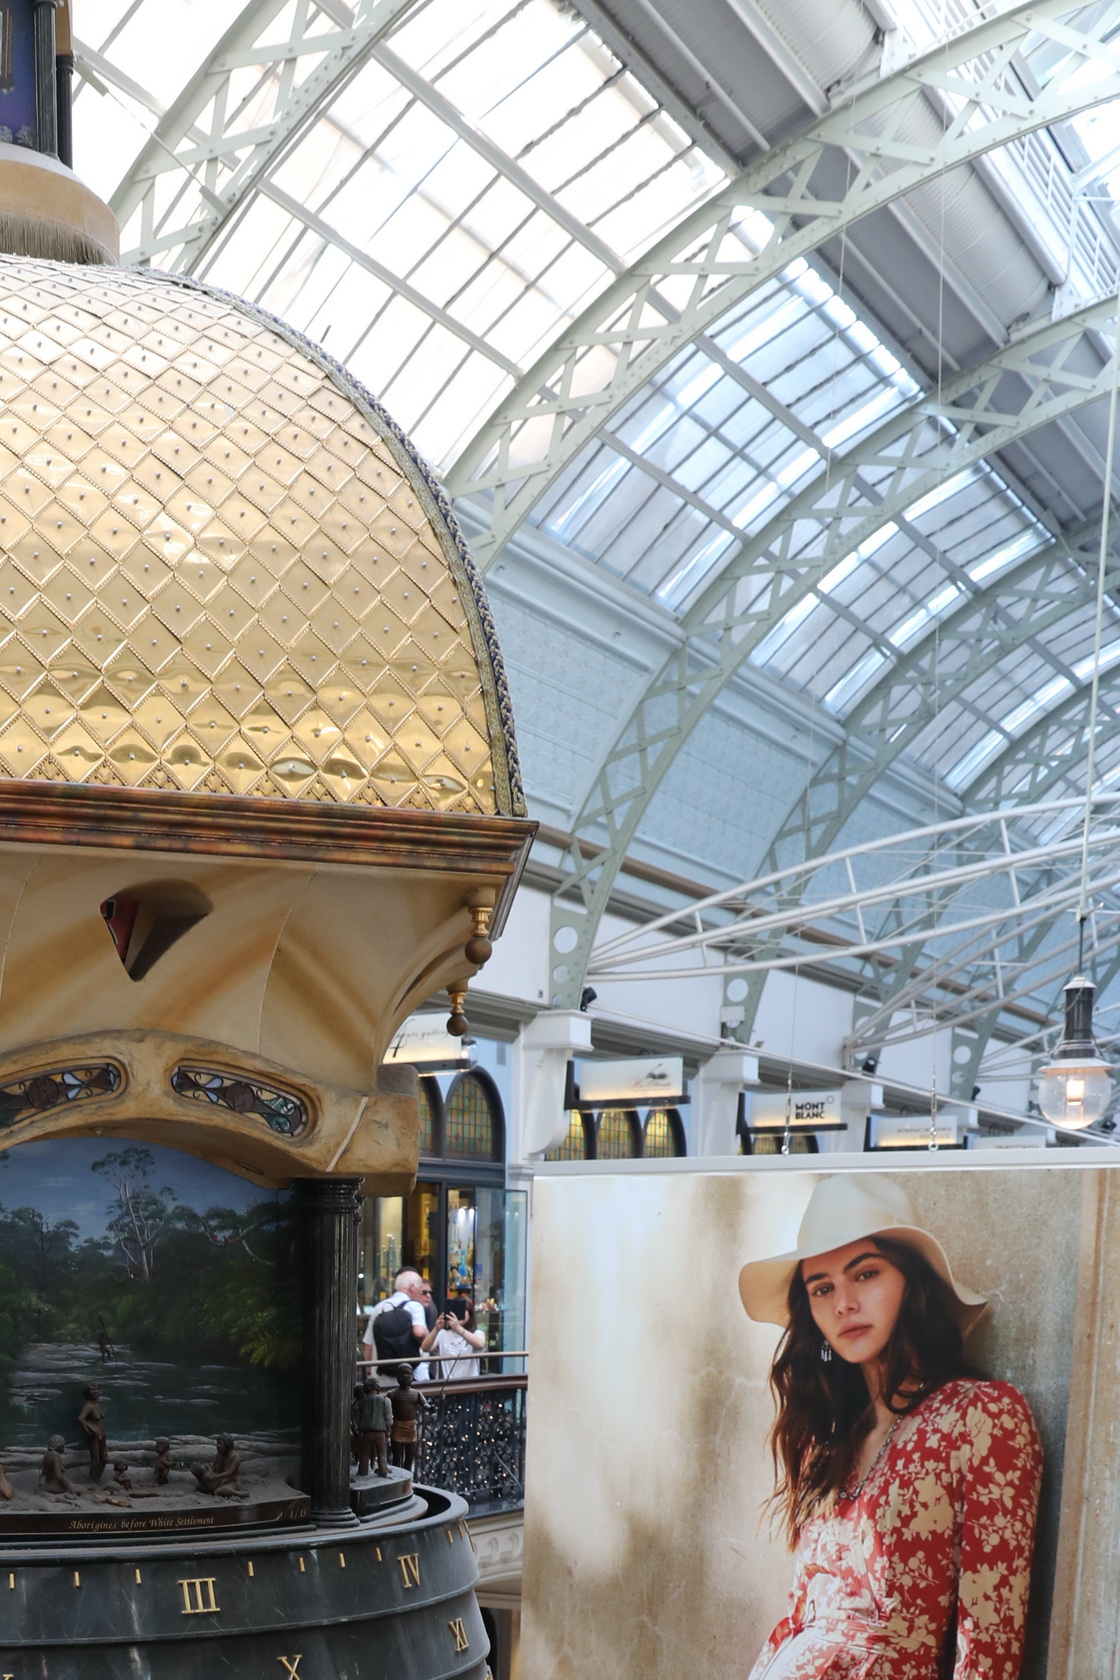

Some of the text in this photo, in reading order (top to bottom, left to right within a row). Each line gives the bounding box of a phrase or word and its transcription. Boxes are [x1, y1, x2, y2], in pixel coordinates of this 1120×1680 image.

[795, 1101, 825, 1110] MONT
[795, 1110, 825, 1120] BLANC
[68, 1516, 214, 1531] Aborigines before White Settlement
[178, 1577, 220, 1614] III
[397, 1553, 421, 1588] IV
[448, 1617, 469, 1652] XI
